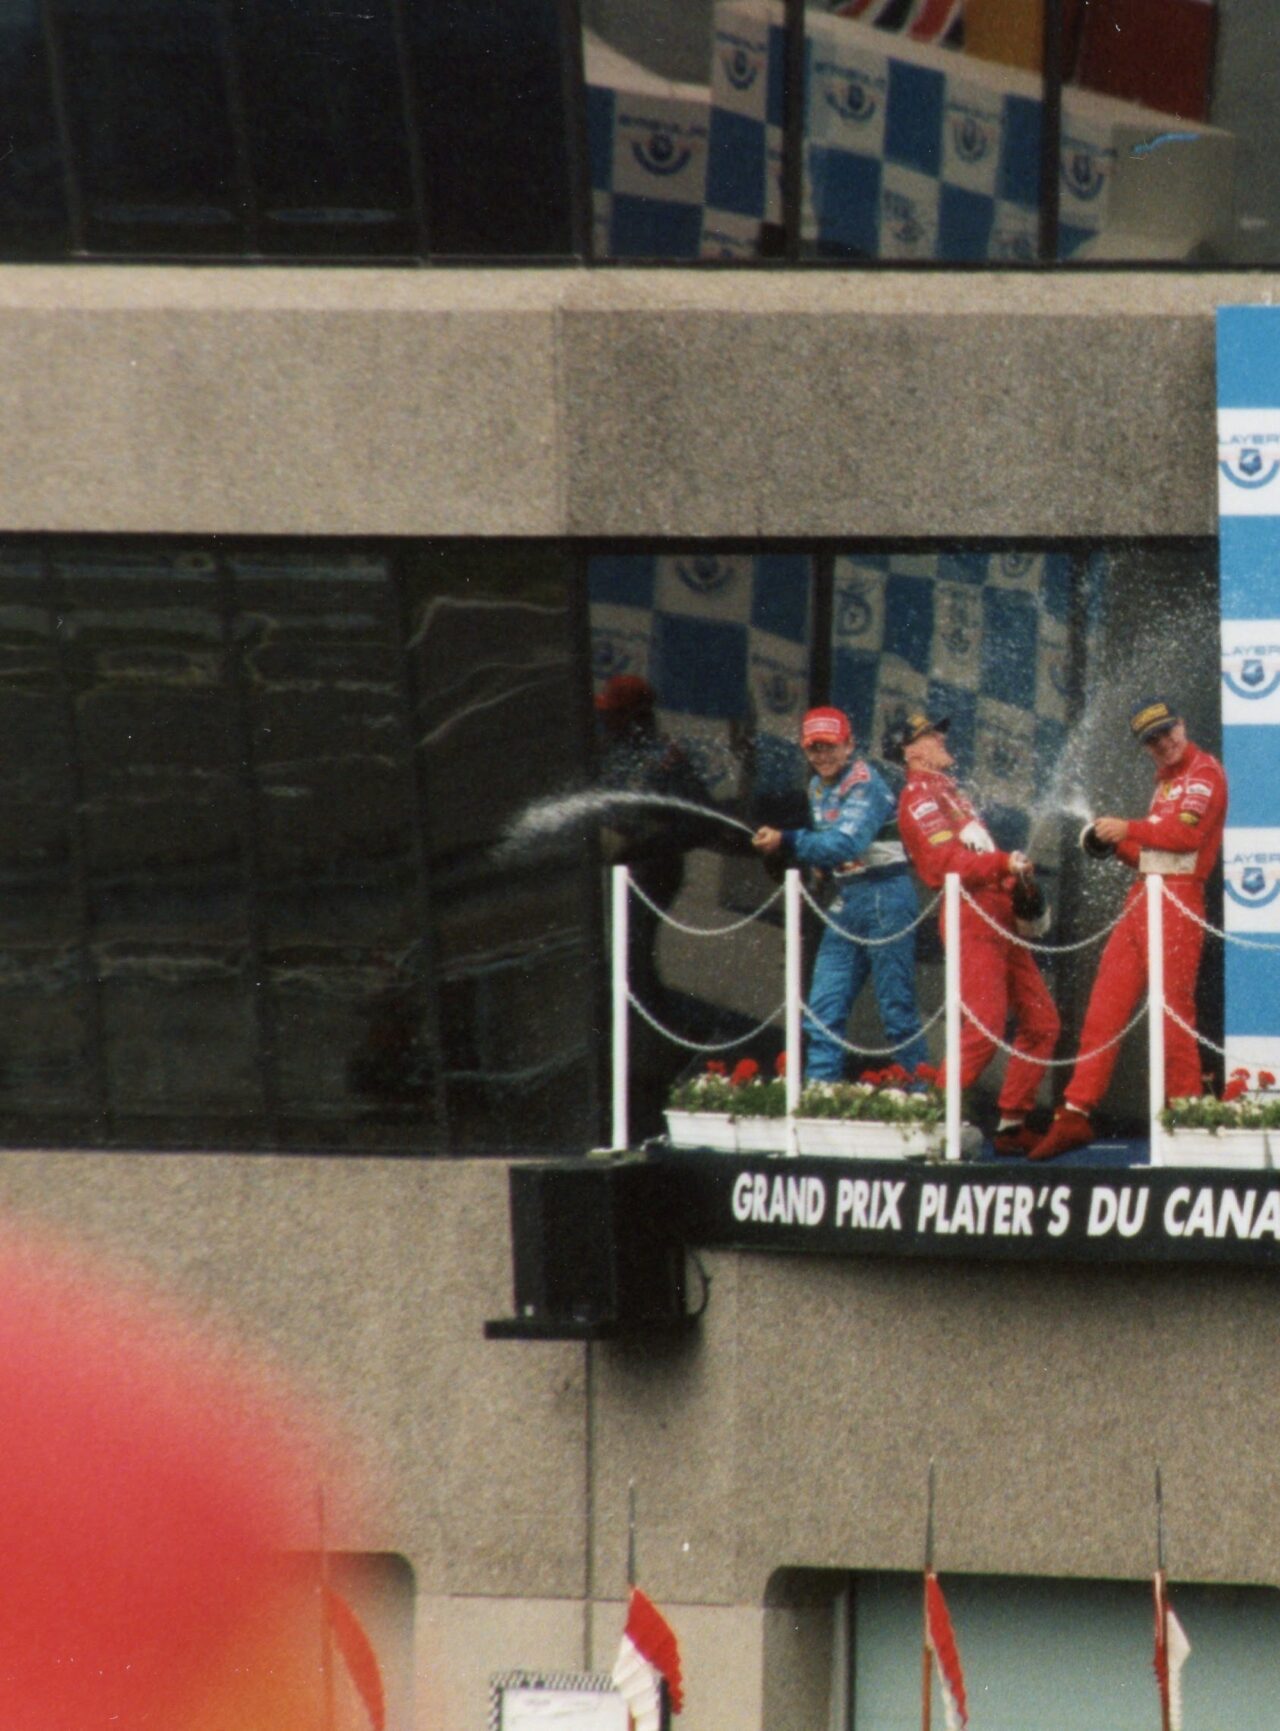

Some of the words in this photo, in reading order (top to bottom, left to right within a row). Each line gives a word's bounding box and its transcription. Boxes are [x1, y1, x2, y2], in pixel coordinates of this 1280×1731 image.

[732, 1171, 826, 1226] GRAND
[836, 1179, 906, 1231] PRIX
[918, 1184, 1072, 1237] PLAYER'S
[1087, 1187, 1149, 1238] DU
